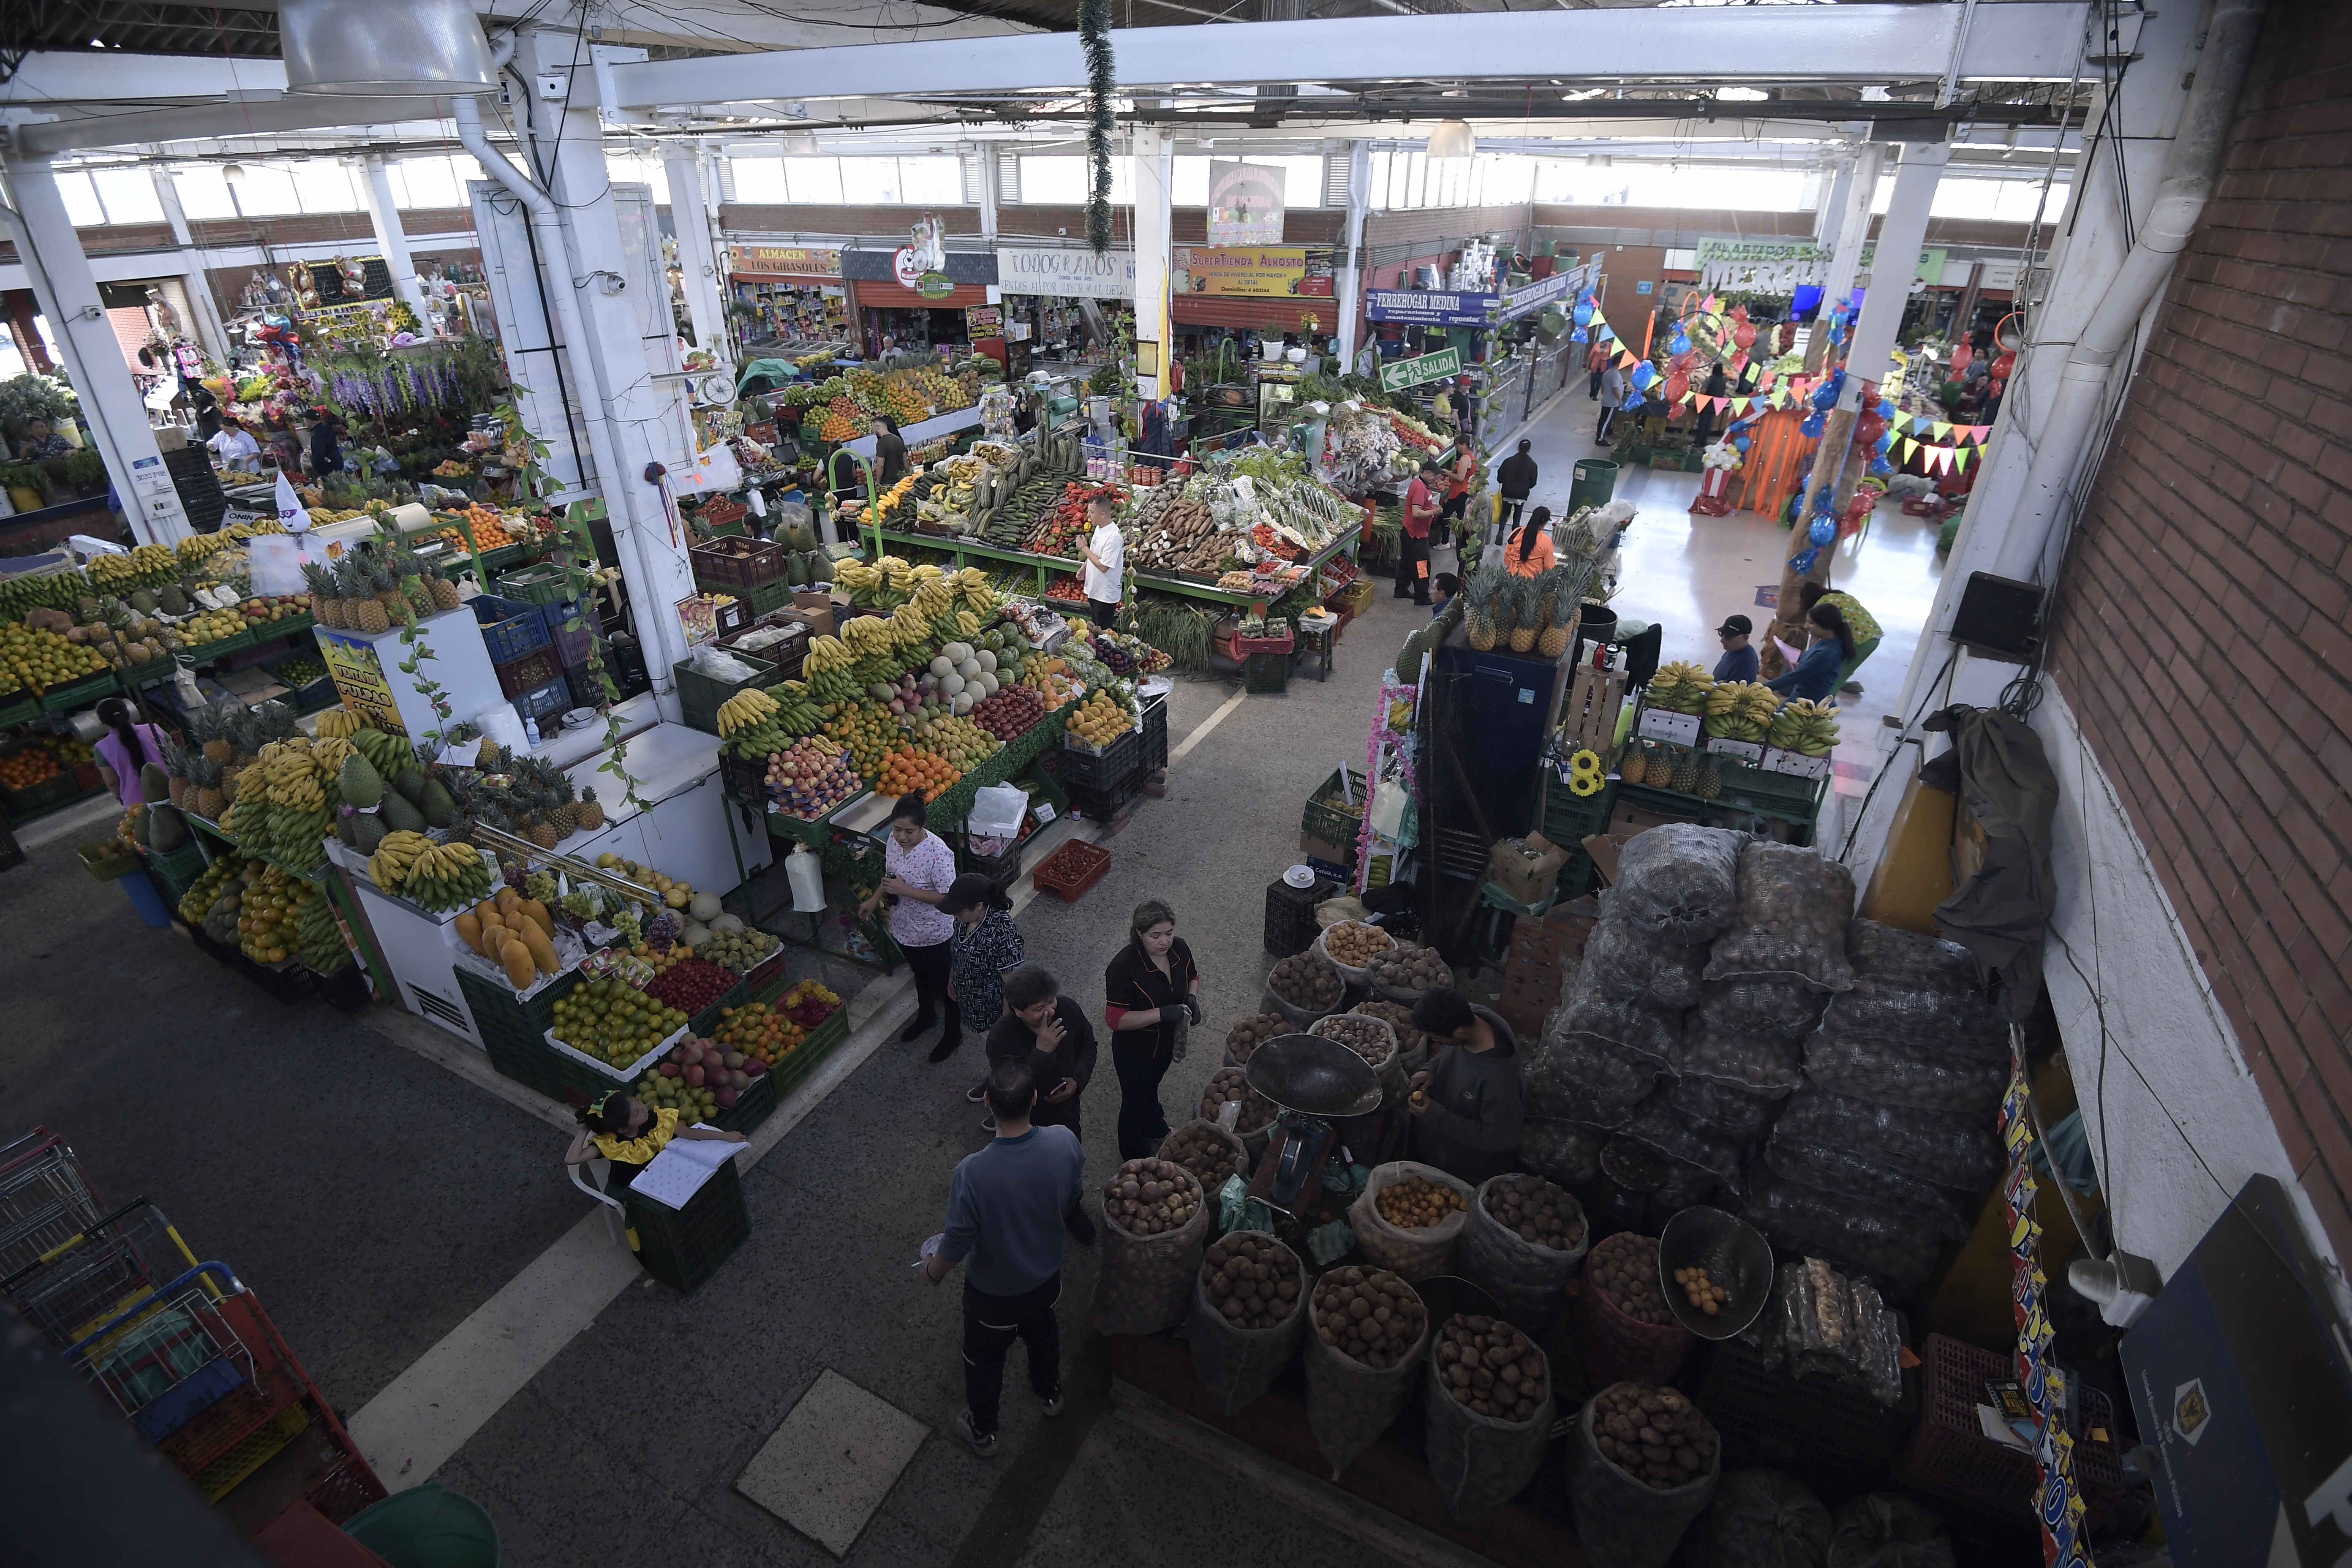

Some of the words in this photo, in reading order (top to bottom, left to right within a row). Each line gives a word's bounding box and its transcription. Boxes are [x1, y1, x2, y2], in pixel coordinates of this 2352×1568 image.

[759, 249, 806, 260] ALMACEN
[1011, 253, 1116, 276] TODOGRANOS
[751, 261, 770, 270] LOS
[773, 262, 827, 273] GIRASOLES
[1000, 280, 1027, 291] VENTAS
[1031, 282, 1040, 292] AL
[1043, 282, 1056, 292] POR
[1106, 285, 1130, 296] DETAL
[1376, 292, 1428, 309] FERREHOGAR
[1429, 295, 1460, 311] MEDINA
[1422, 356, 1456, 376] SALIDA
[334, 663, 367, 683] VENTA
[363, 671, 380, 687] DE
[336, 680, 392, 708] PULPAS
[2163, 1421, 2174, 1444] UESP
[2141, 1369, 2152, 1396] Unidad
[2159, 1441, 2173, 1480] Servicios
[2170, 1479, 2183, 1518] Públicos
